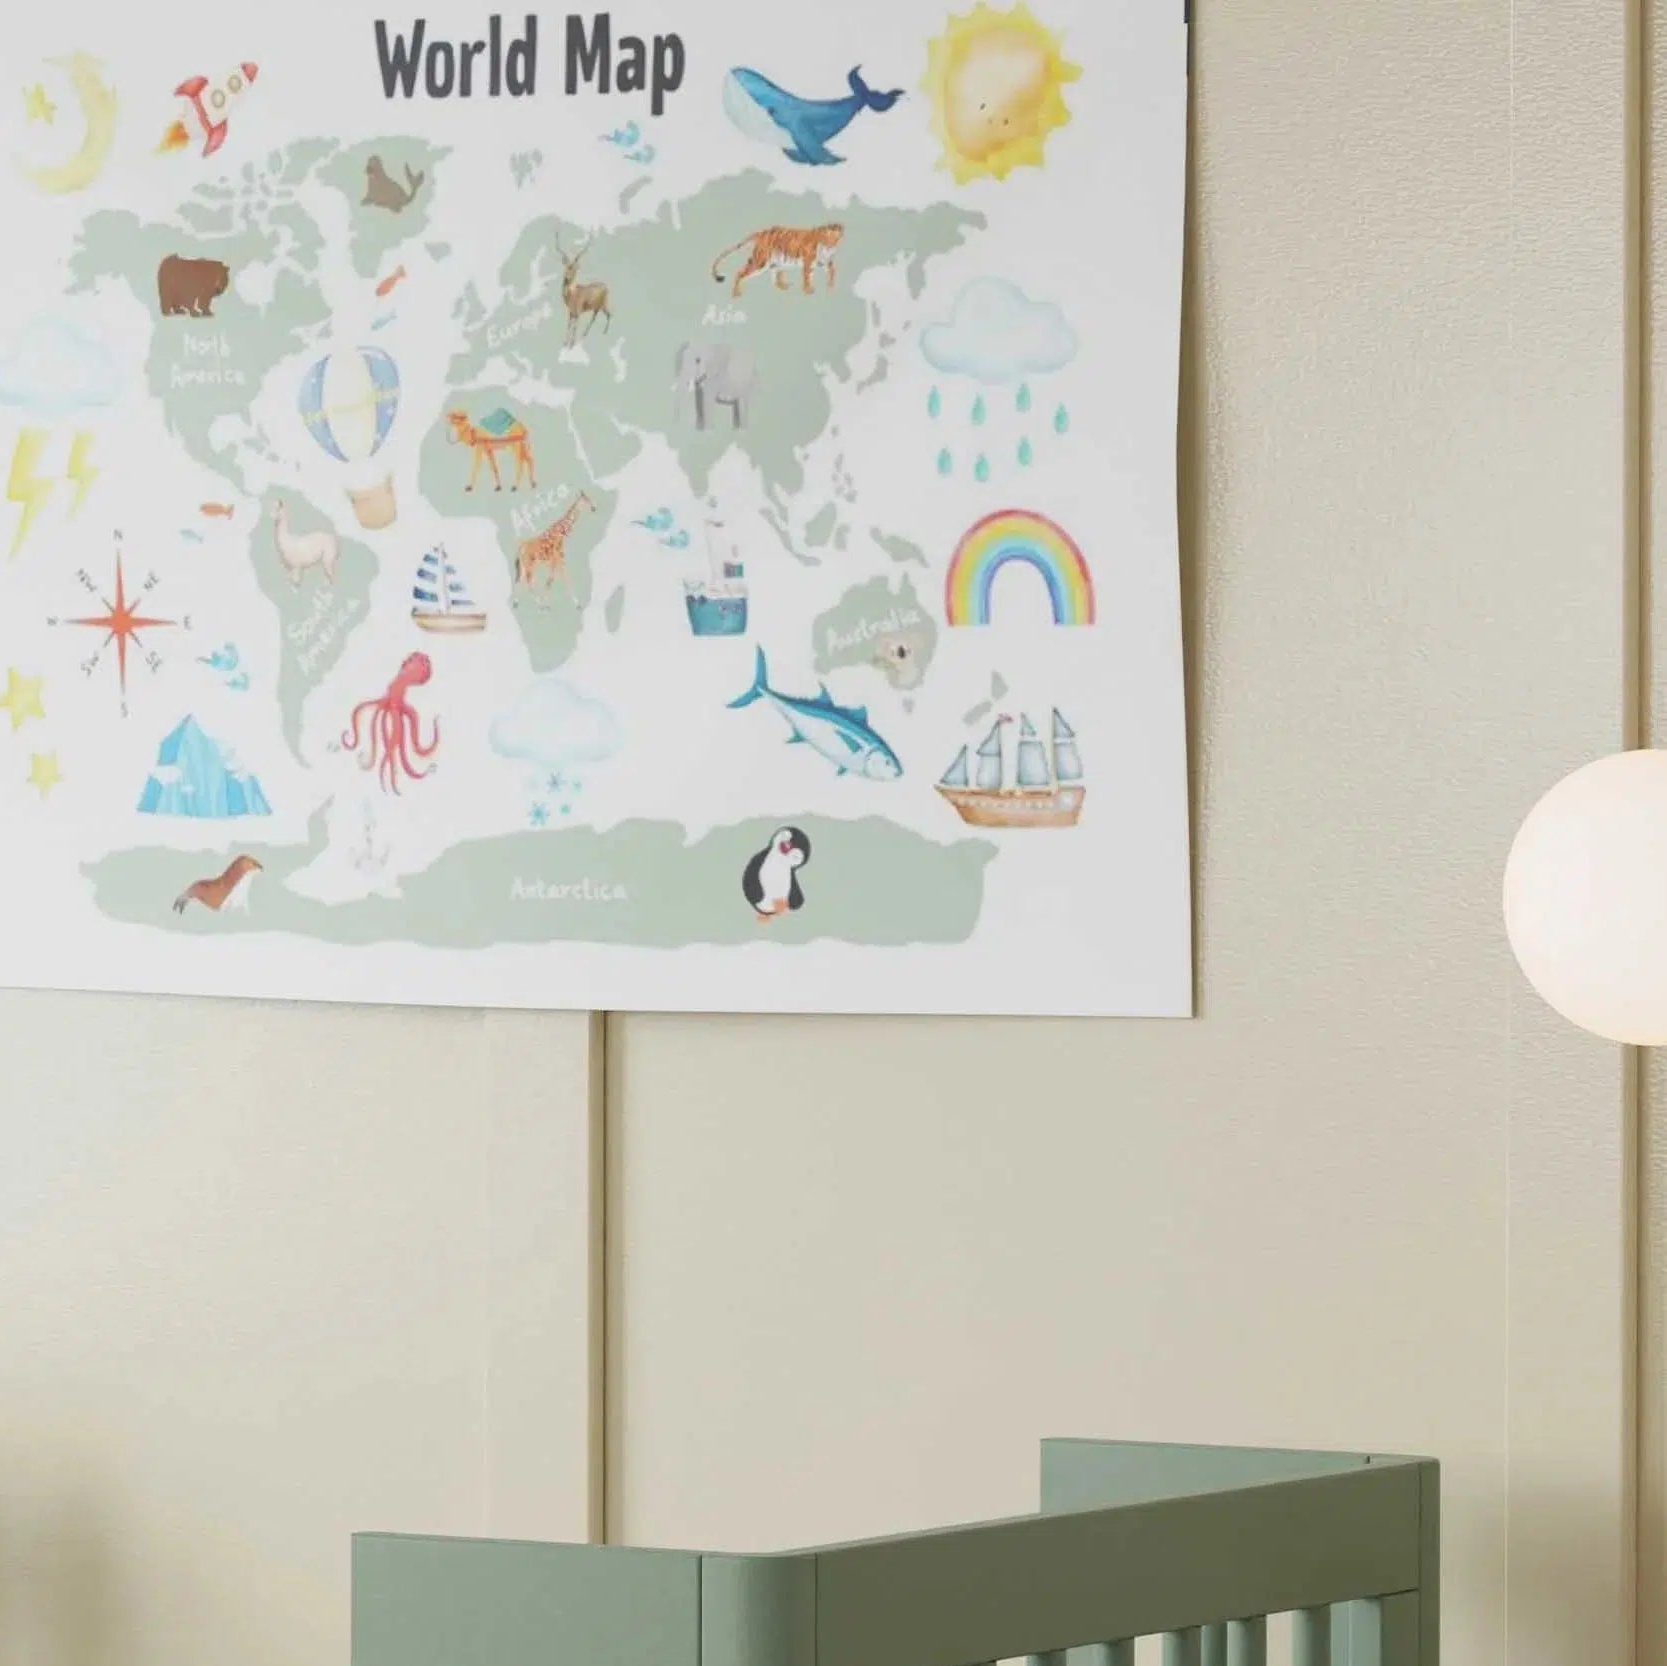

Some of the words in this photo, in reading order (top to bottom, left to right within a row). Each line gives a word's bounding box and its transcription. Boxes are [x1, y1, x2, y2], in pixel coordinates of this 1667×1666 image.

[374, 14, 538, 99] World
[565, 12, 685, 117] Map
[113, 529, 124, 541] N
[509, 874, 627, 901] Antarctica
